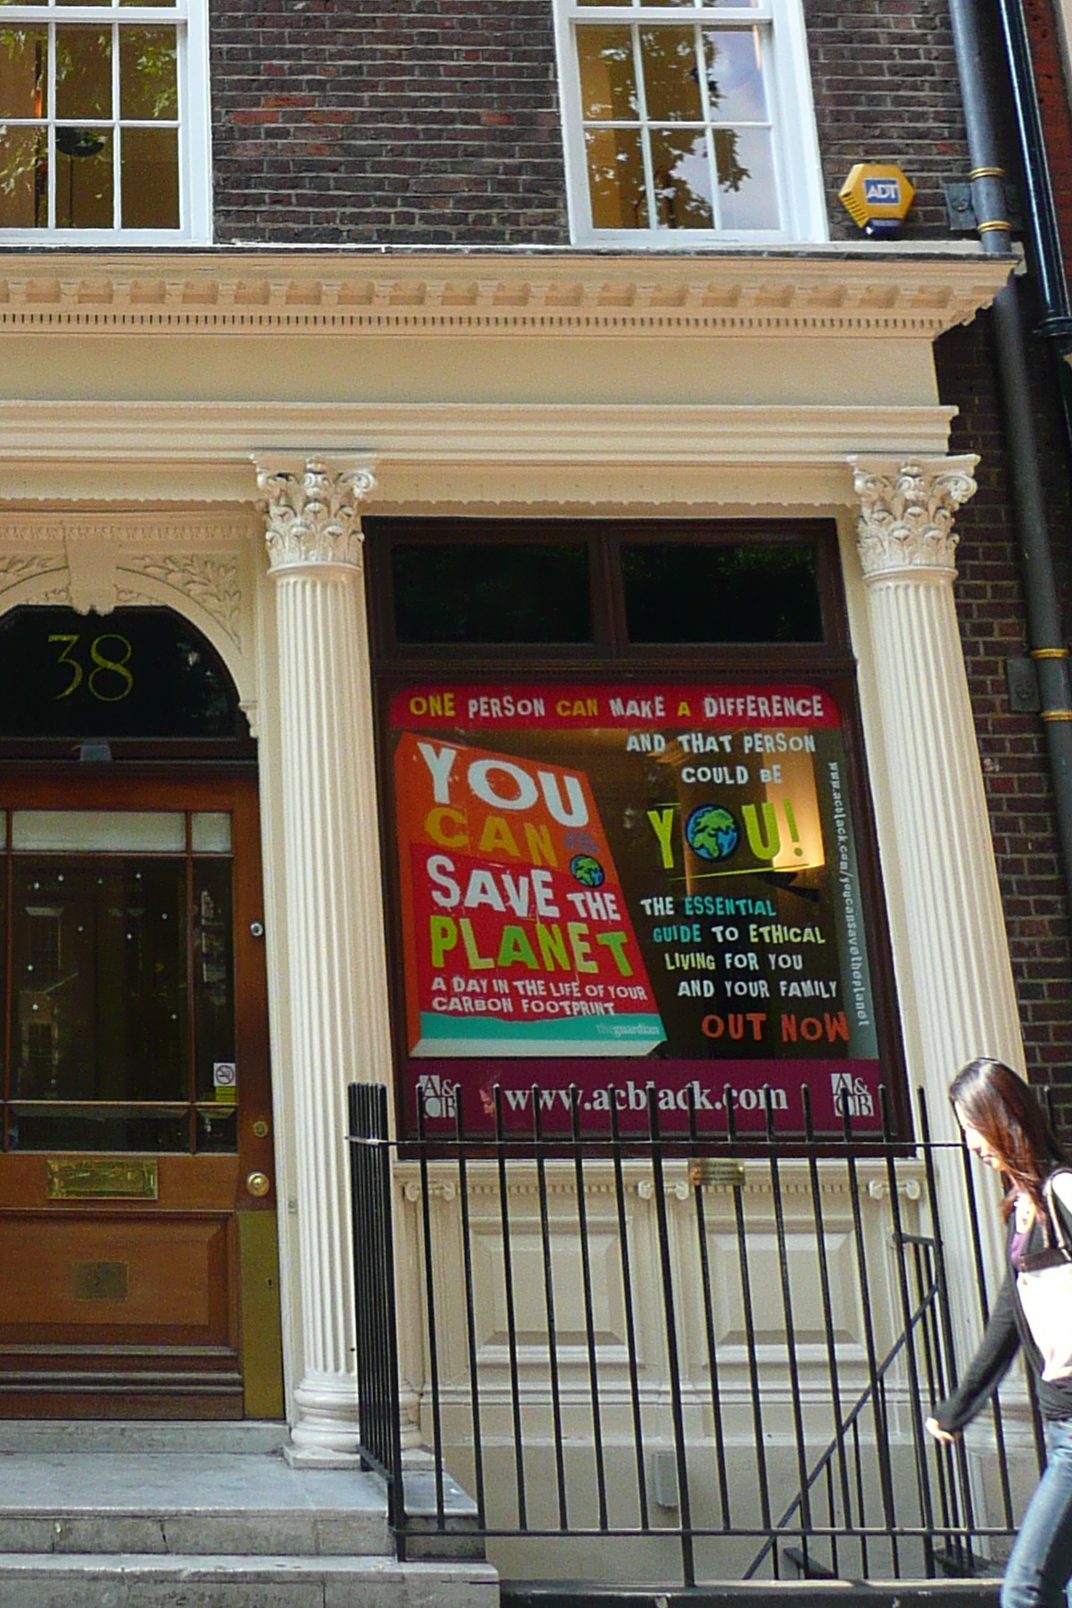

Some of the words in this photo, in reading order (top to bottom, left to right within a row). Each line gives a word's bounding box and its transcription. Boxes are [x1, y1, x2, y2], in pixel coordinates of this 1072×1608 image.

[867, 184, 897, 199] ADT
[47, 633, 134, 702] 38
[409, 692, 456, 717] ONE
[468, 695, 546, 719] PERSON
[556, 698, 599, 717] CAN
[609, 696, 666, 719] MAKE
[678, 701, 691, 716] A
[703, 694, 824, 718] DIFFERENCE
[626, 733, 666, 753] AND
[678, 732, 732, 753] THAT
[743, 732, 816, 753] PERSON
[416, 741, 589, 828] YOU
[681, 765, 749, 785] COULD
[760, 764, 783, 784] BE
[424, 806, 559, 868] CAN
[426, 854, 561, 918] SAVE
[567, 891, 621, 921] THE
[640, 896, 674, 916] THE
[684, 896, 777, 917] ESSENTIAL
[653, 923, 702, 943] GUIDE
[711, 925, 739, 943] TO
[749, 924, 826, 944] ETHICAL
[429, 914, 634, 977] PLANET
[665, 952, 716, 971] LIVING
[725, 952, 759, 971] FOR
[768, 954, 803, 970] YOU
[431, 976, 447, 991] A
[453, 976, 488, 993] DAY
[492, 979, 509, 994] IN
[513, 980, 547, 996] THE
[550, 981, 581, 998] LIFE
[585, 985, 605, 998] OF
[608, 985, 648, 1000] YOUR
[678, 980, 715, 997] AND
[725, 980, 770, 998] YOUR
[780, 979, 837, 999] FAMILY
[432, 996, 513, 1013] CARBON
[522, 998, 615, 1017] FOOTPRINT
[701, 1013, 767, 1041] OUT
[781, 1011, 850, 1043] NOW
